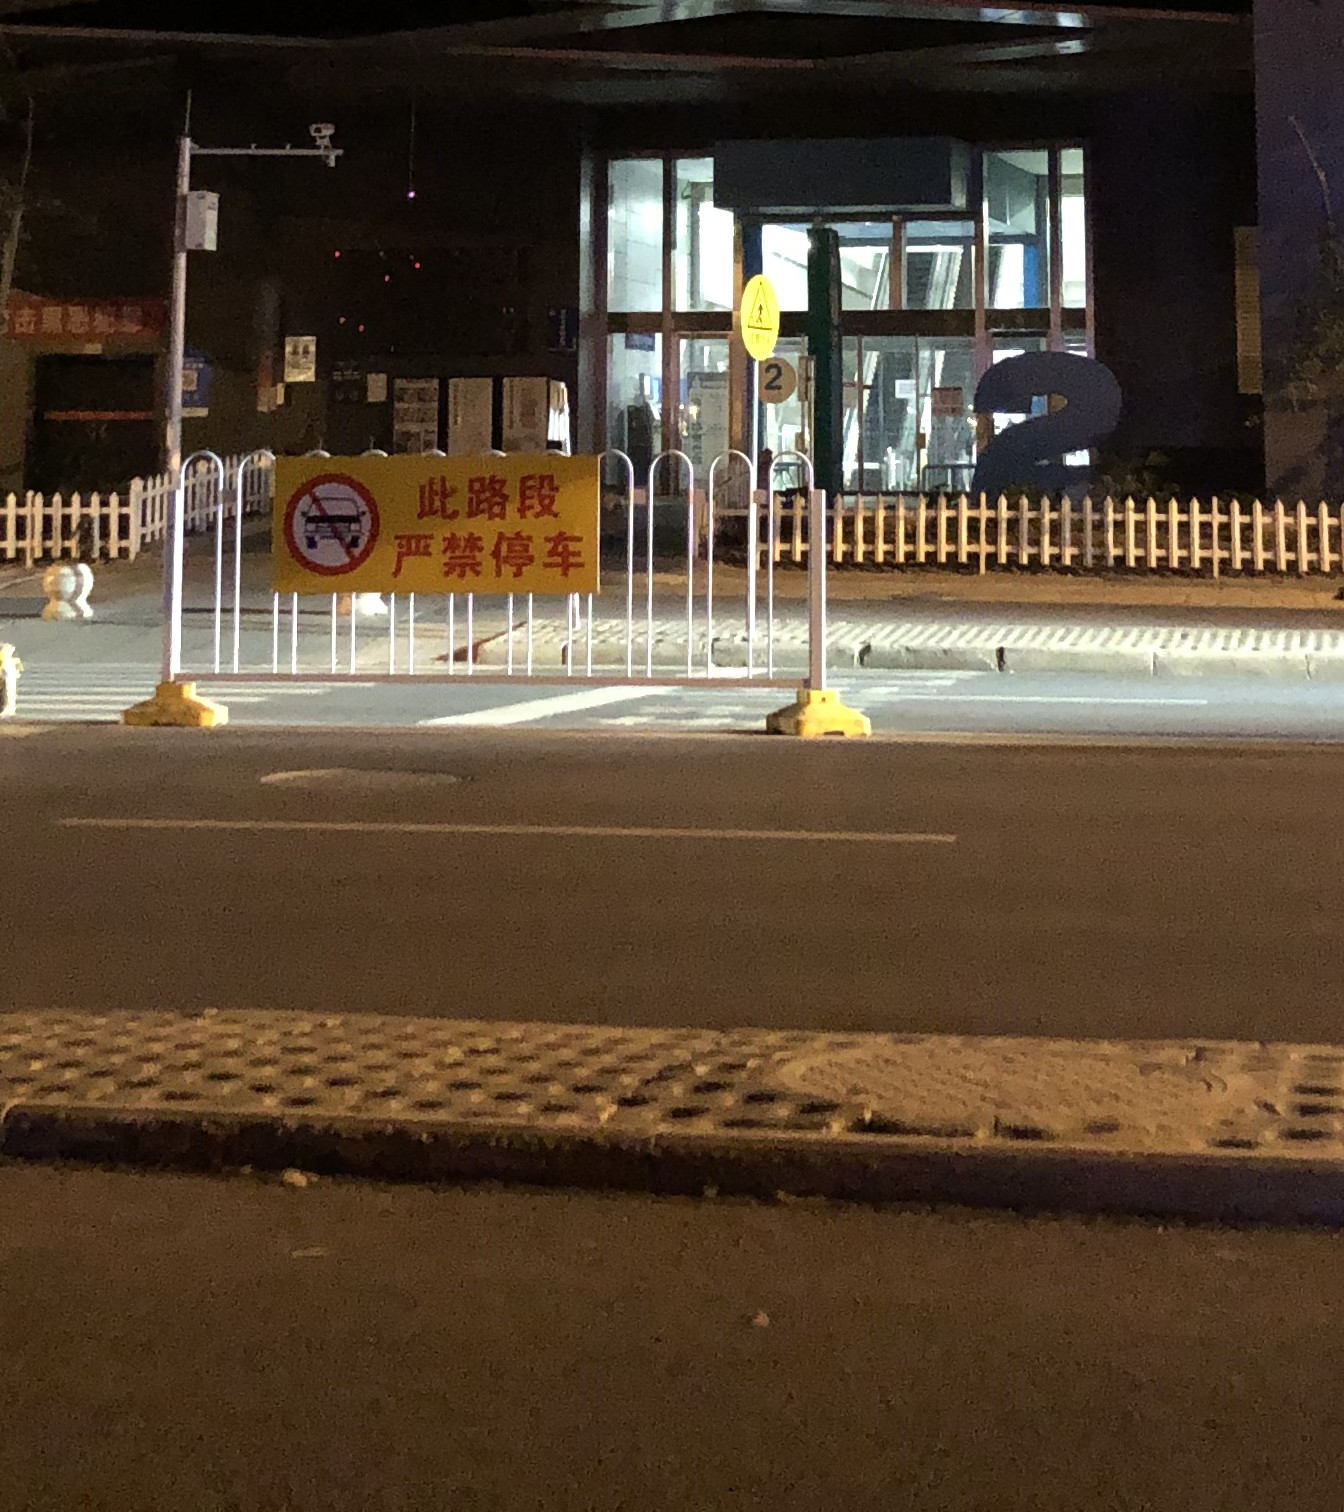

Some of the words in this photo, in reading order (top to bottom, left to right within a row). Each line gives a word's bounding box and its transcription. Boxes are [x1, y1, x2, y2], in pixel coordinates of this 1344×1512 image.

[764, 363, 783, 391] 2
[972, 351, 1123, 502] 2
[417, 474, 560, 520] 此路段
[392, 531, 585, 578] 严禁停车
